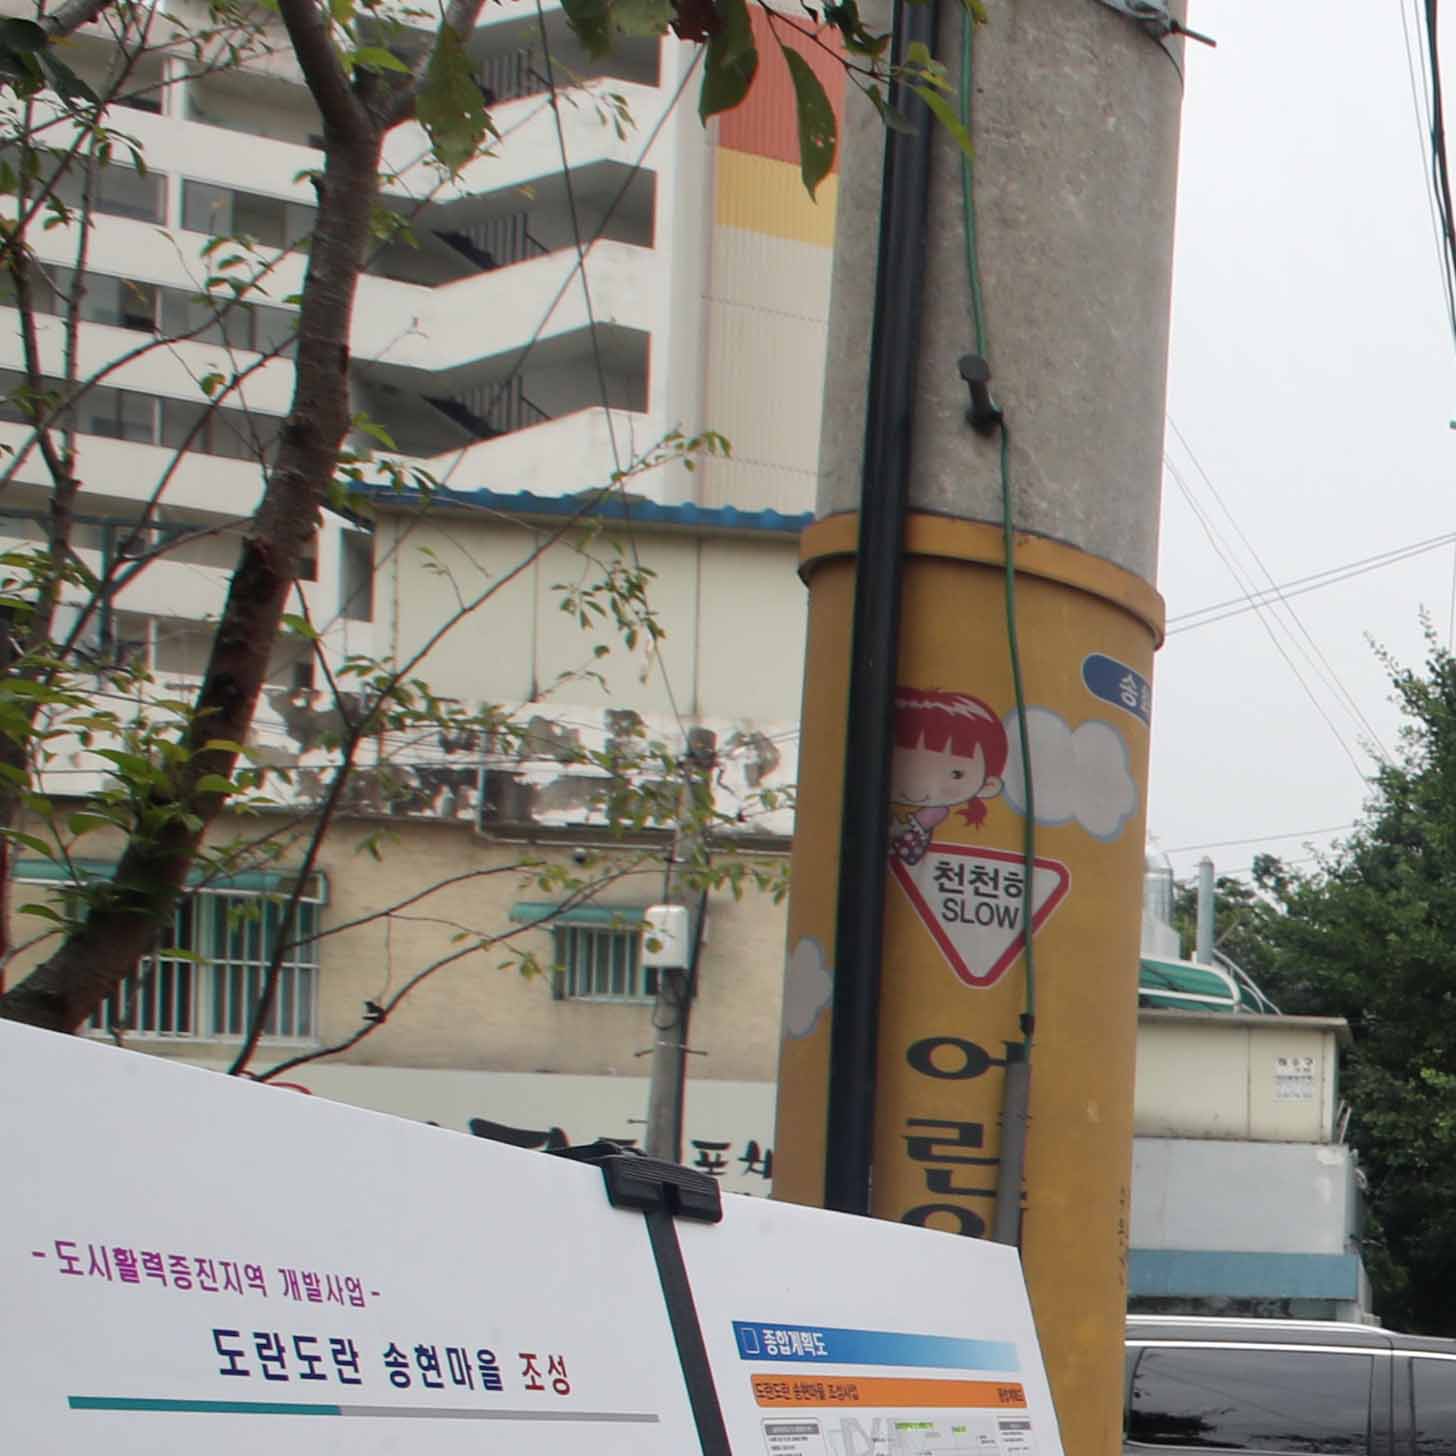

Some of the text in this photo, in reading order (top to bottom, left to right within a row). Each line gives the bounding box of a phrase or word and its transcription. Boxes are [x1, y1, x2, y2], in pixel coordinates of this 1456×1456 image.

[941, 897, 1020, 930] SLOW
[55, 1240, 366, 1308] 도시활력증진지역 개발사업
[213, 1329, 572, 1396] 도란도란 송현마을 조성
[762, 1329, 827, 1355] 종합계획도
